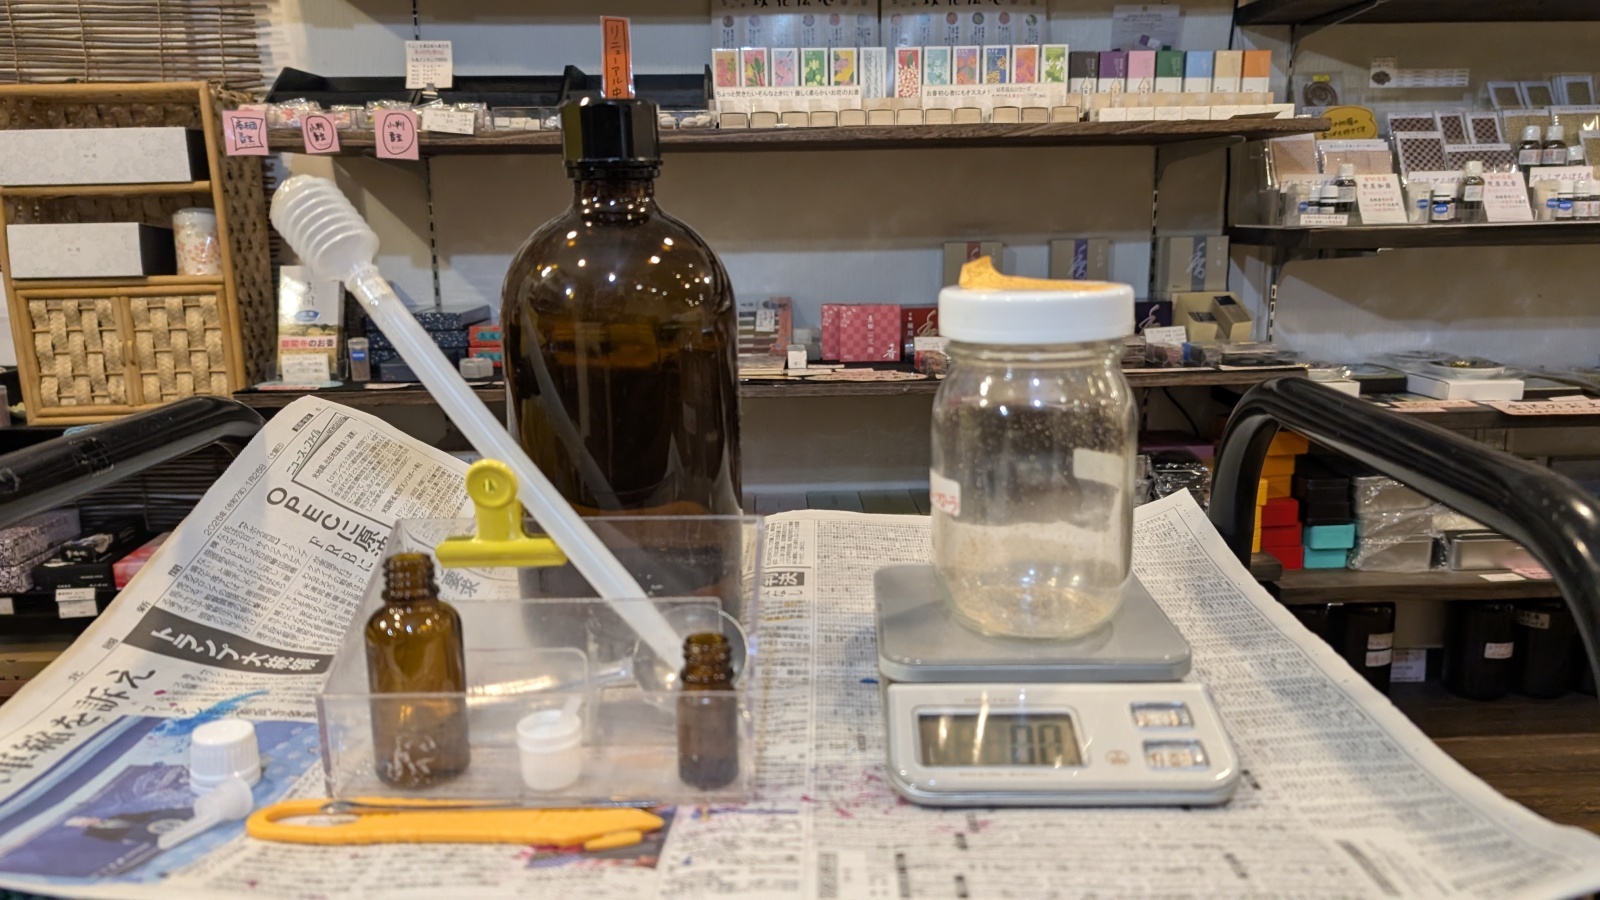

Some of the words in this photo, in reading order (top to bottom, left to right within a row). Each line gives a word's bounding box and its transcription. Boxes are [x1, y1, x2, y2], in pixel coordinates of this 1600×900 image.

[610, 25, 622, 98] リニューアル中
[308, 535, 374, 572] FRBに
[150, 625, 321, 671] トランプ大統領
